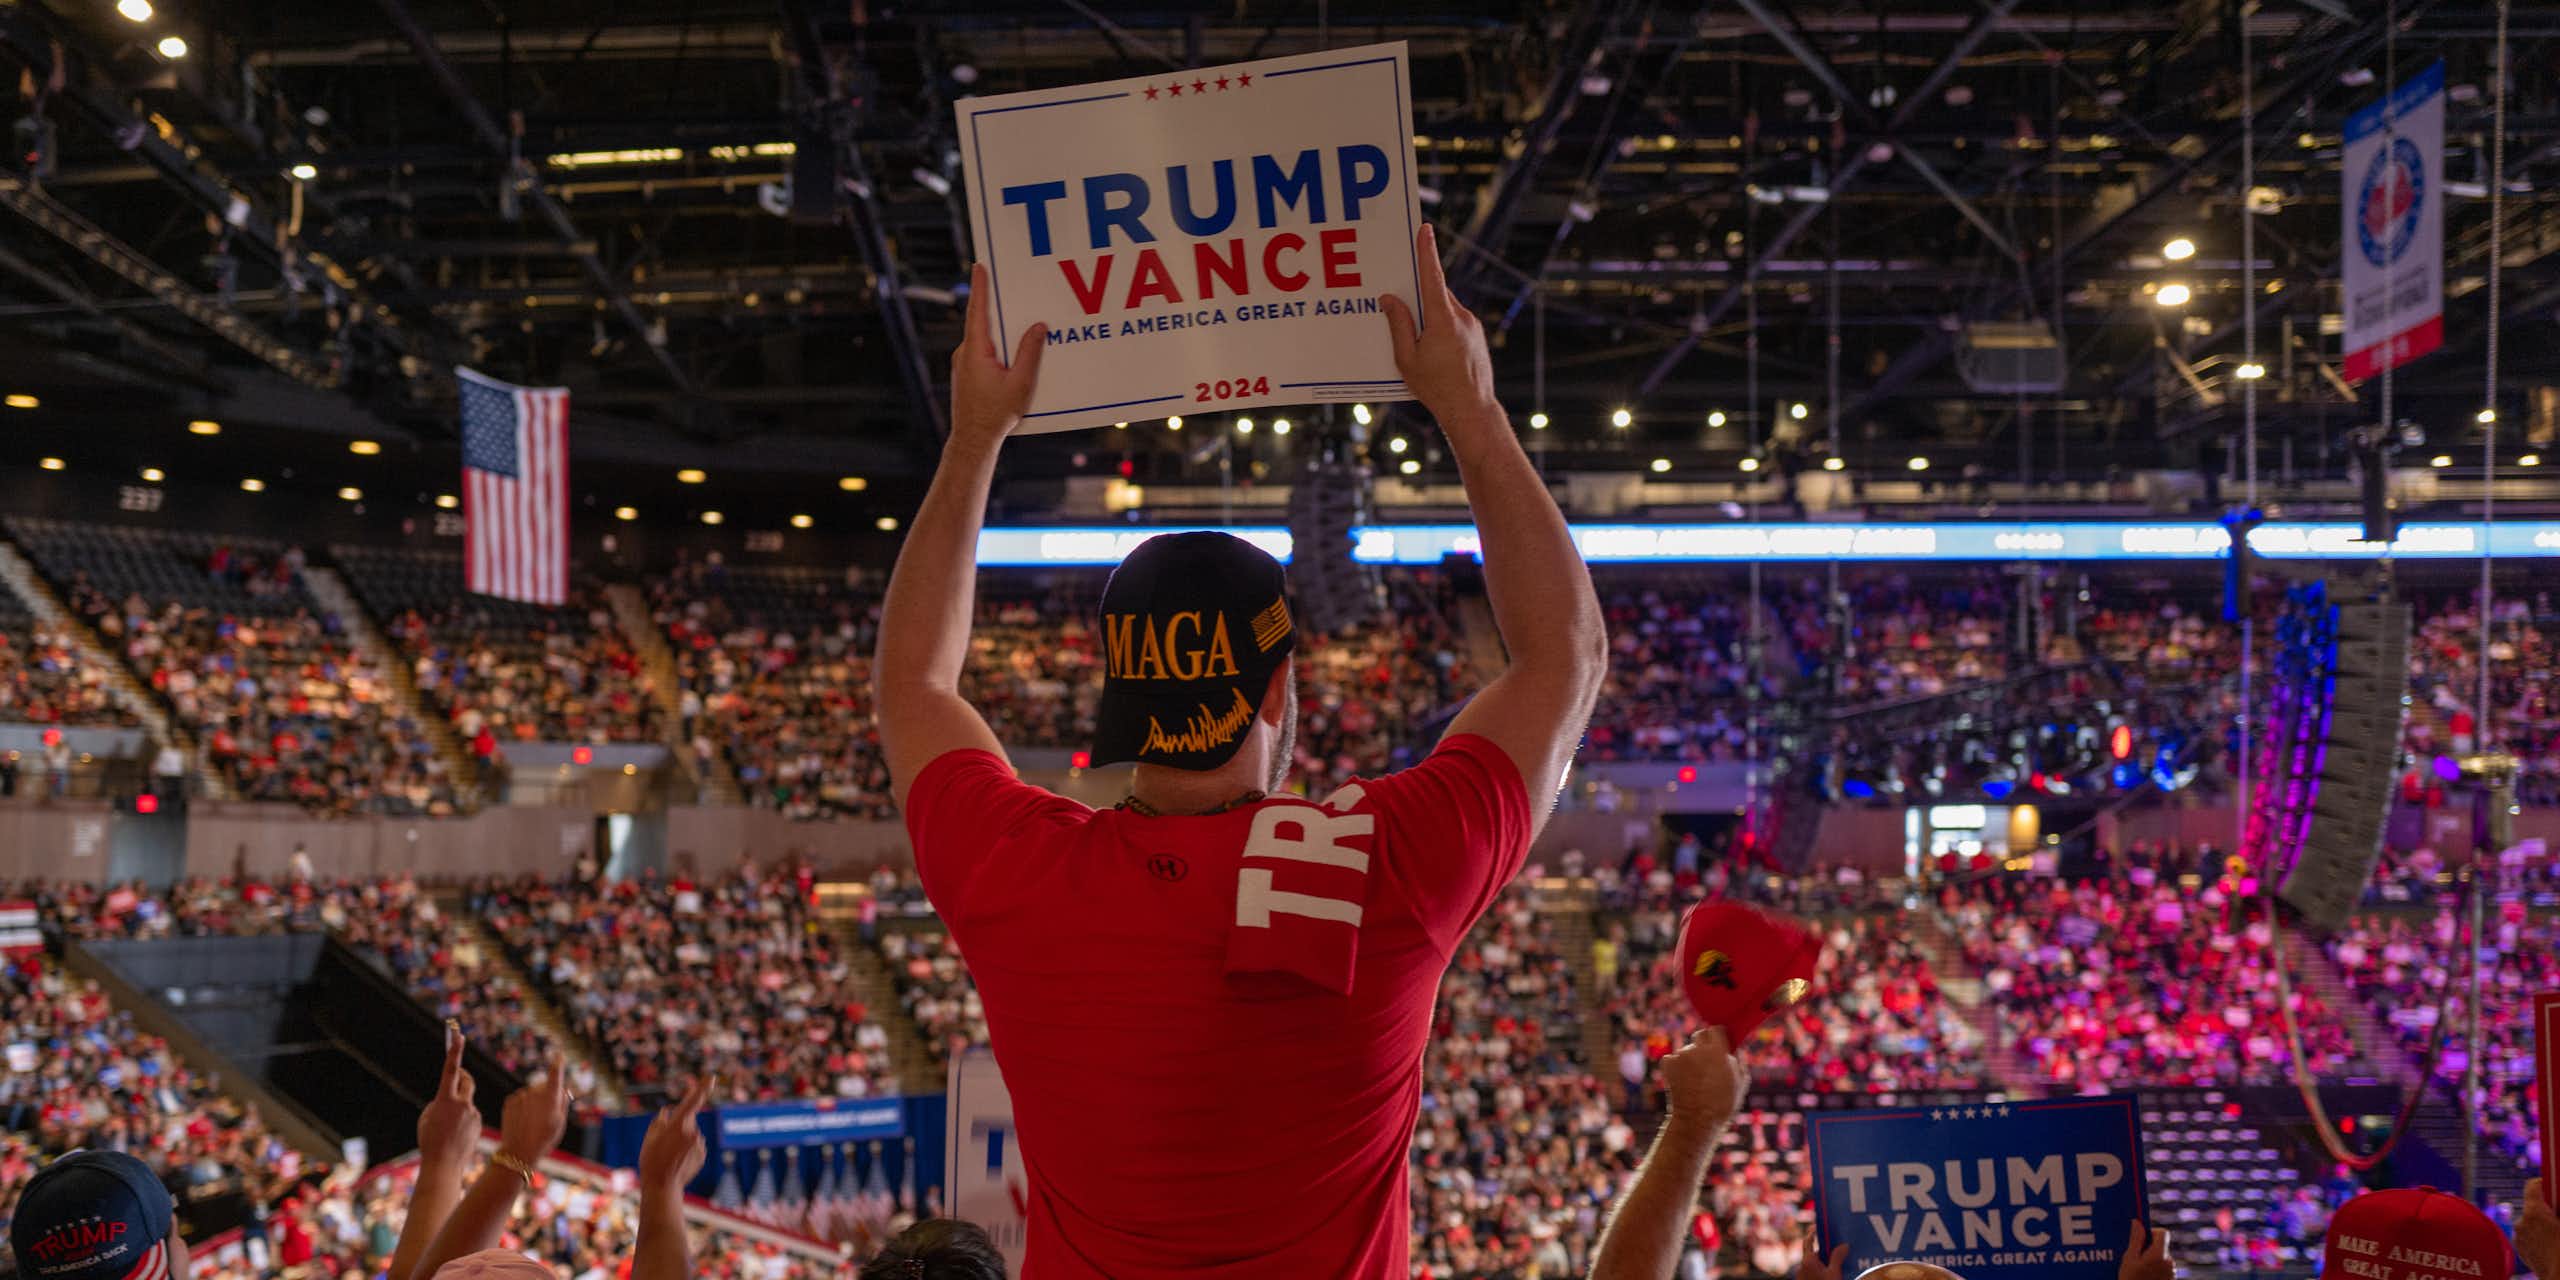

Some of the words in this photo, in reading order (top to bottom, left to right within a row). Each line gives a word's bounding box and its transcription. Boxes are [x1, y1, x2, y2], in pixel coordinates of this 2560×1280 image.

[1002, 143, 1390, 257] TRUMP
[1058, 228, 1362, 315] VANCE
[1047, 323, 1112, 346] MAKE
[1120, 311, 1227, 336] AMERICA
[1237, 302, 1306, 322] GREAT
[1195, 376, 1270, 402] 2024
[1105, 610, 1240, 680] MAGA
[1833, 1152, 2124, 1213] TRUMP
[31, 1220, 129, 1262] TRUMP
[1869, 1205, 2097, 1253] VANCE
[1992, 1252, 2046, 1265] GREAT
[2053, 1249, 2114, 1263] AGAIN!
[2337, 1234, 2379, 1256] MAKE
[2388, 1245, 2482, 1276] AMERICA
[2342, 1258, 2393, 1280] GREAT
